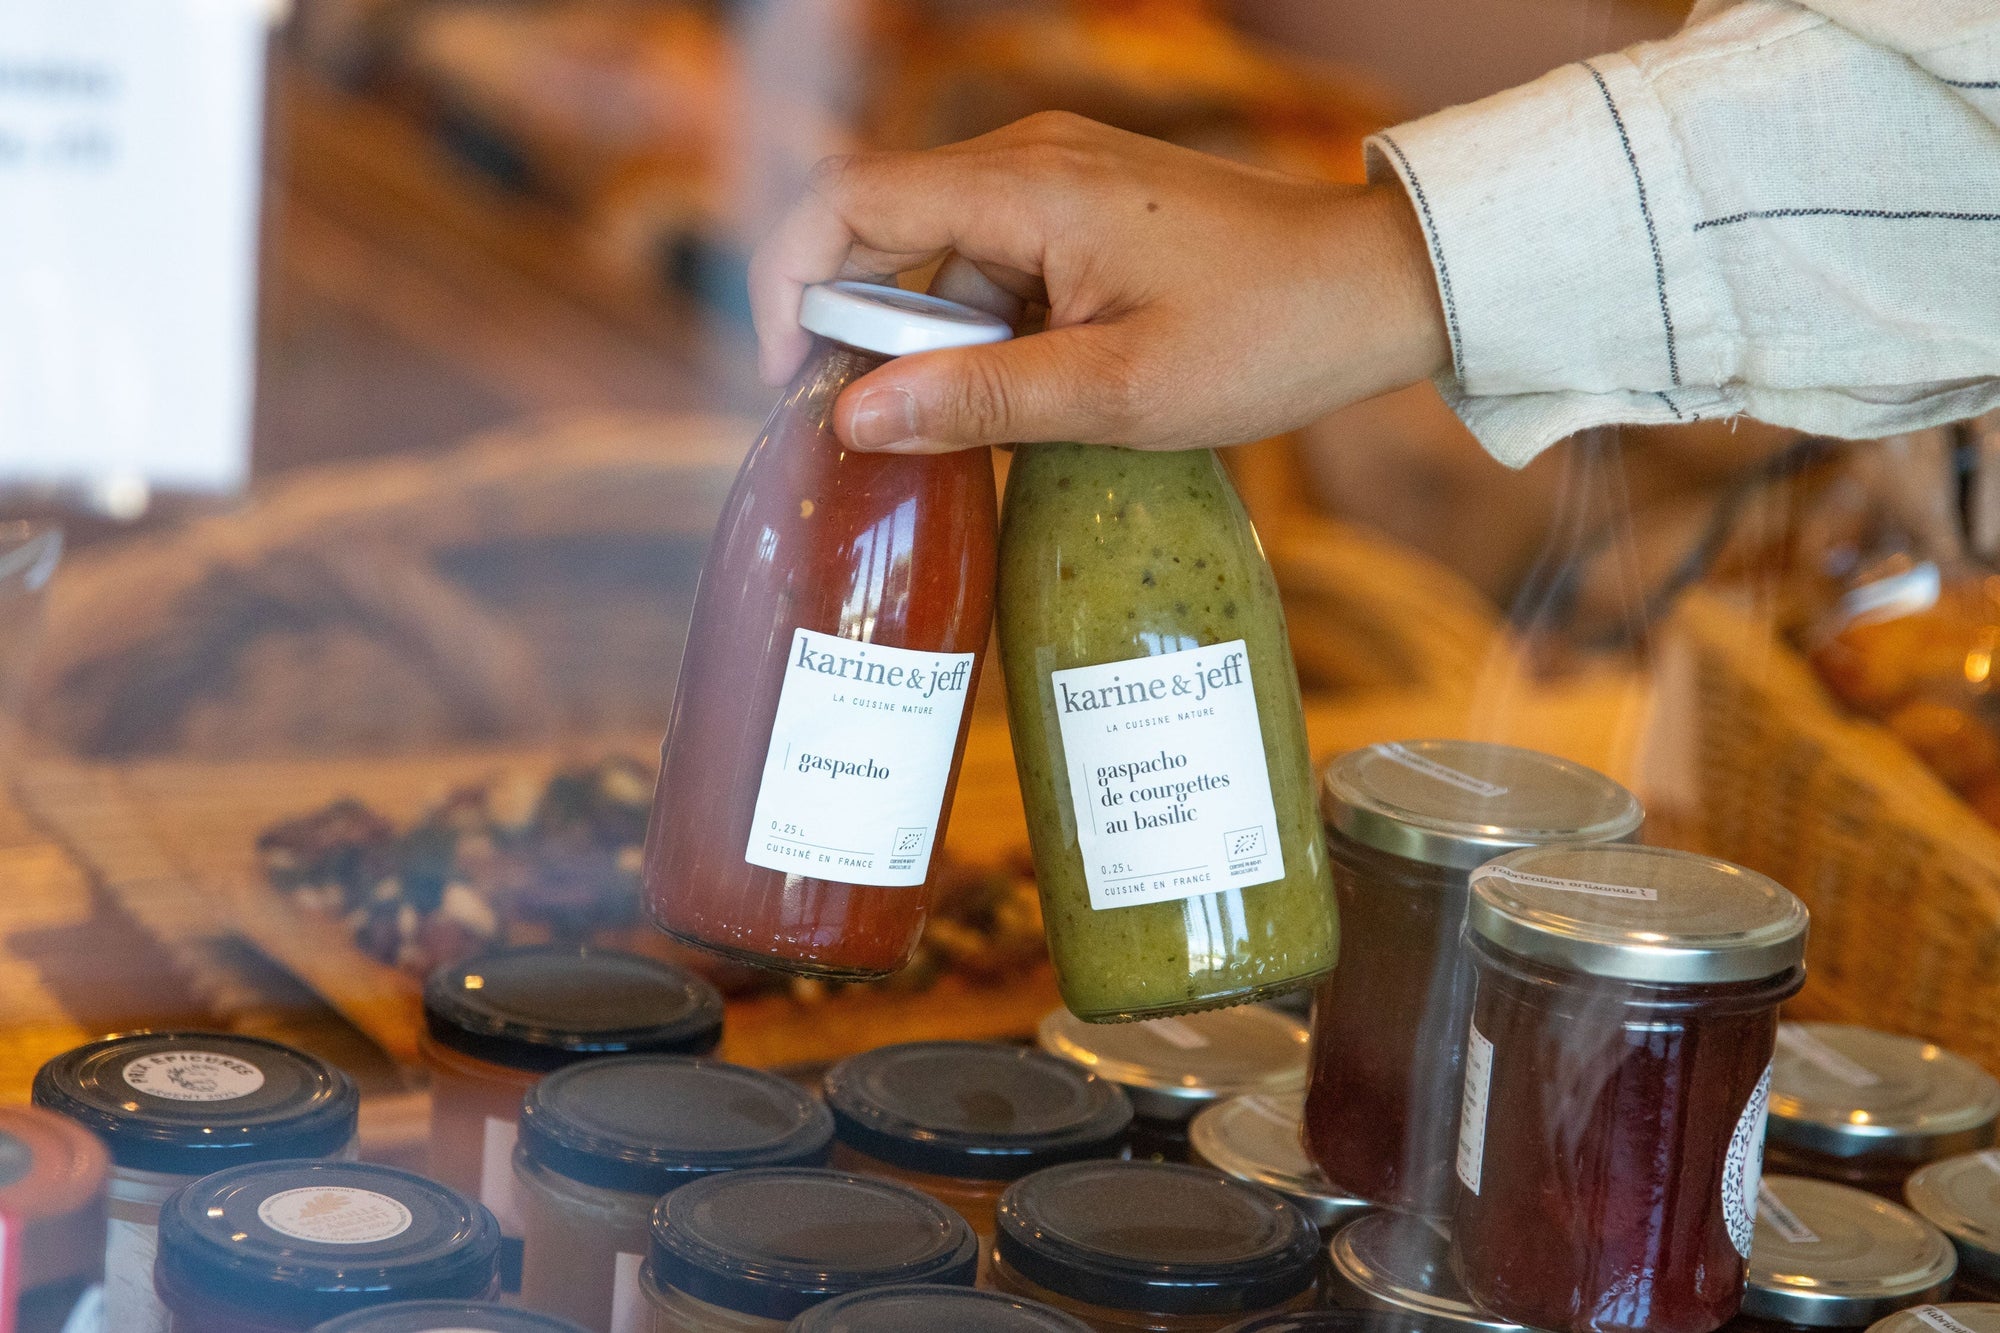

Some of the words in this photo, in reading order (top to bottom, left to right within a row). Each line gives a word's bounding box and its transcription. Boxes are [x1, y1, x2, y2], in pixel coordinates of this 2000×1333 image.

[796, 637, 904, 686] karine
[906, 668, 926, 690] &
[922, 660, 970, 698] jeff
[1060, 675, 1166, 713] karine
[1171, 675, 1192, 696] &
[1195, 652, 1243, 700] jeff
[833, 693, 845, 703] LA
[852, 697, 895, 712] CUISINE
[902, 705, 933, 715] NATURE
[1106, 723, 1118, 733] LA
[1125, 714, 1171, 730] CUISINE
[1177, 707, 1215, 721] NATURE
[798, 752, 890, 780] gaspacho
[1097, 750, 1187, 787] gaspacho
[1101, 789, 1123, 807] de
[1130, 772, 1230, 803] courgettes
[771, 820, 797, 835] 0.25
[799, 828, 805, 837] L
[1106, 821, 1128, 834] au
[1133, 803, 1198, 831] basilic
[766, 843, 811, 860] CUISINÉ
[818, 854, 830, 863] EN
[838, 857, 873, 869] FRANCE
[1101, 863, 1124, 875] 0.25
[1127, 863, 1133, 872] L
[1104, 882, 1146, 896] CUISINÉ
[1153, 880, 1166, 889] EN
[1173, 873, 1211, 887] FRANCE
[1569, 881, 1637, 895] artisanale
